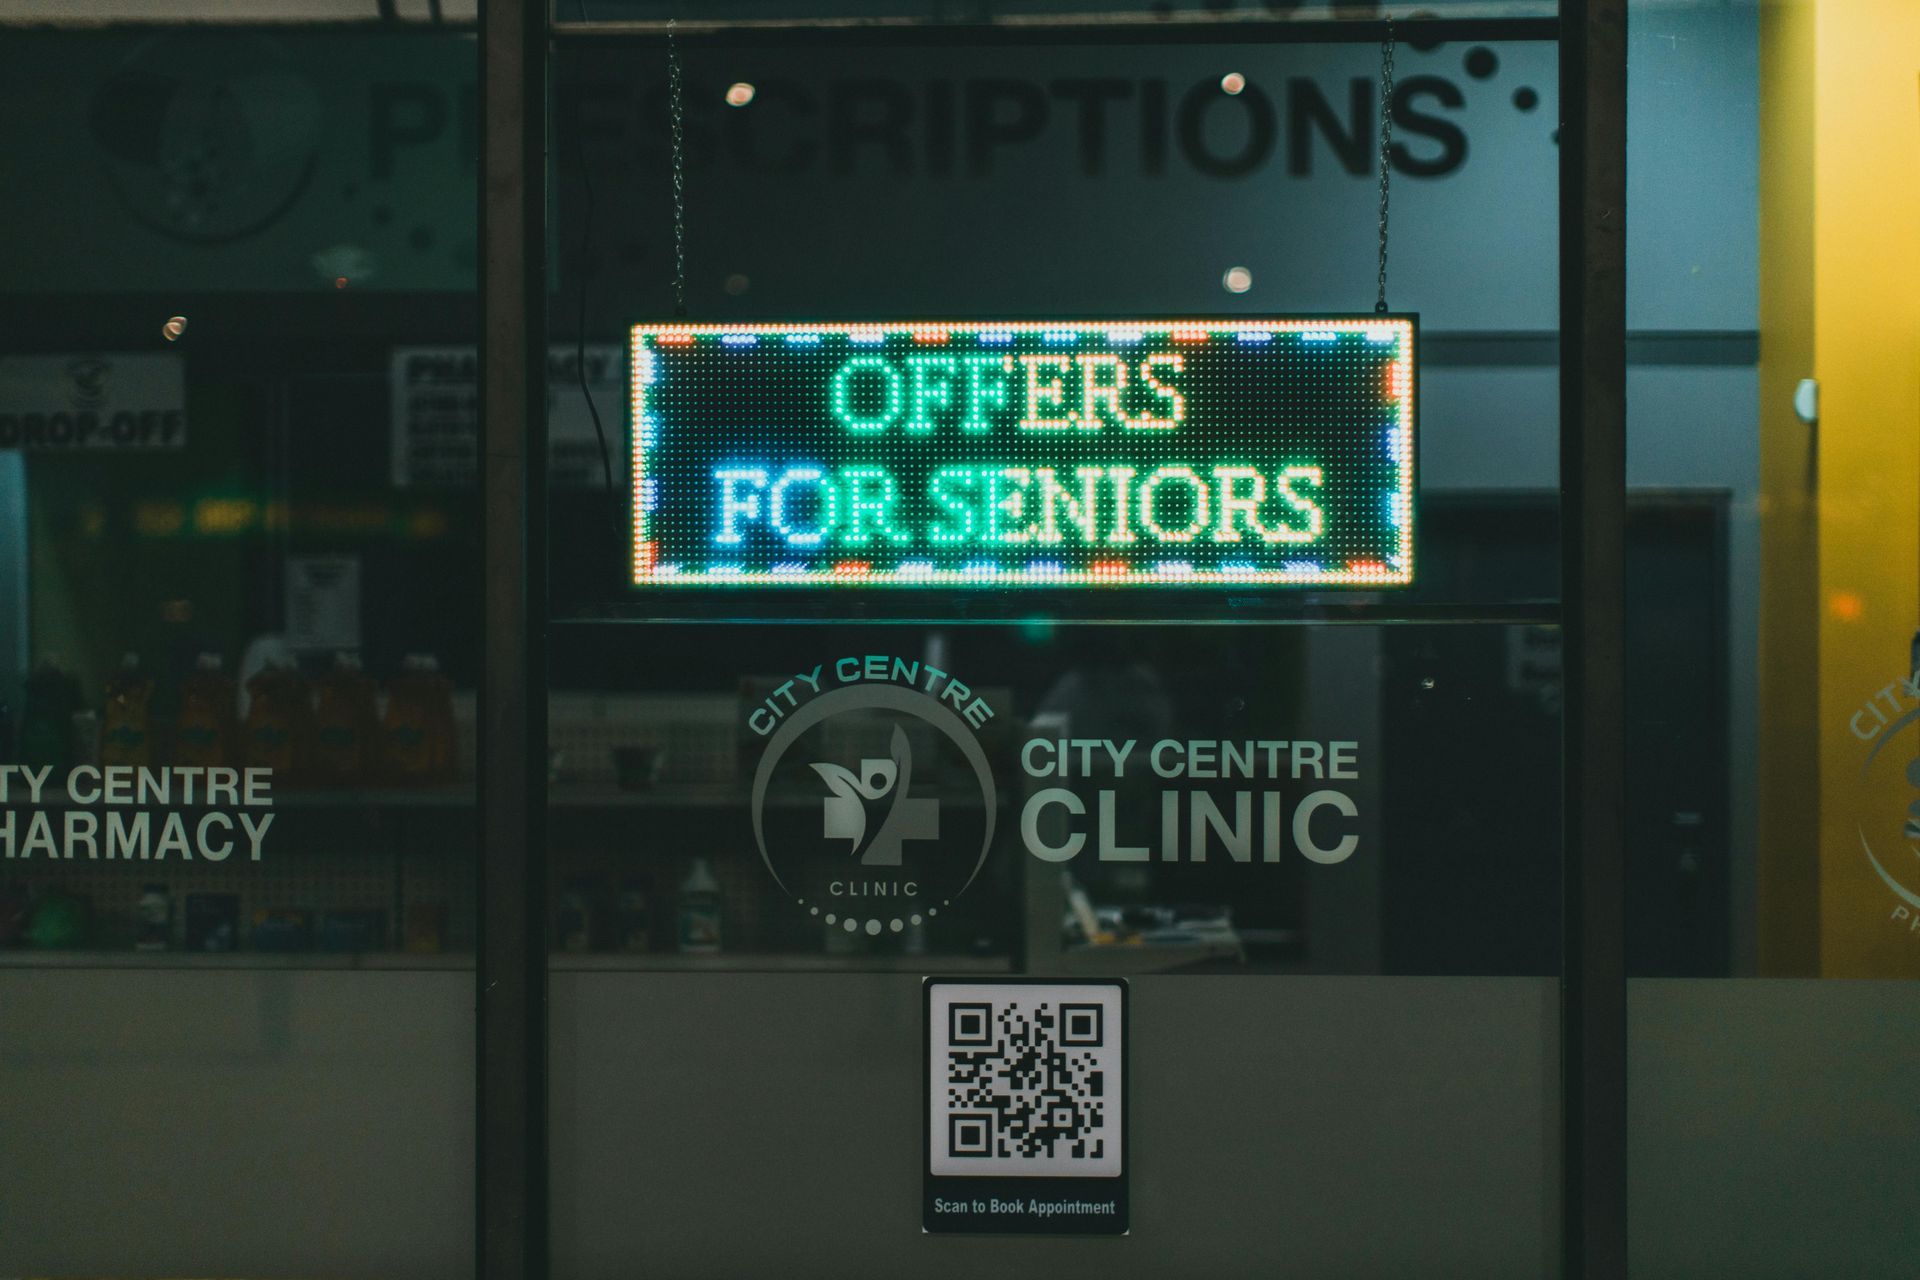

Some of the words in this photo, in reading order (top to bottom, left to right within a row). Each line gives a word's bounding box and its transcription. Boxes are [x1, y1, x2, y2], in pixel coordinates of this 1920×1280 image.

[369, 76, 1469, 181] PESCRIPTIONS
[832, 353, 1186, 433] OFFERS
[0, 410, 182, 447] DROP-OFF
[712, 465, 911, 546] FOR
[930, 465, 1327, 546] SENIORS
[748, 664, 823, 736] CITY
[835, 655, 995, 730] CENTRE
[1021, 738, 1137, 778] CITY
[1151, 739, 1359, 779] CENTRE
[67, 764, 273, 806] CENTRE
[0, 811, 275, 862] HARMACY
[1020, 787, 1360, 865] CLINIC
[829, 881, 919, 897] CLINIC
[934, 1198, 968, 1214] Scan
[972, 1199, 986, 1214] to
[990, 1198, 1025, 1214] Book
[1028, 1198, 1116, 1218] Appointment
